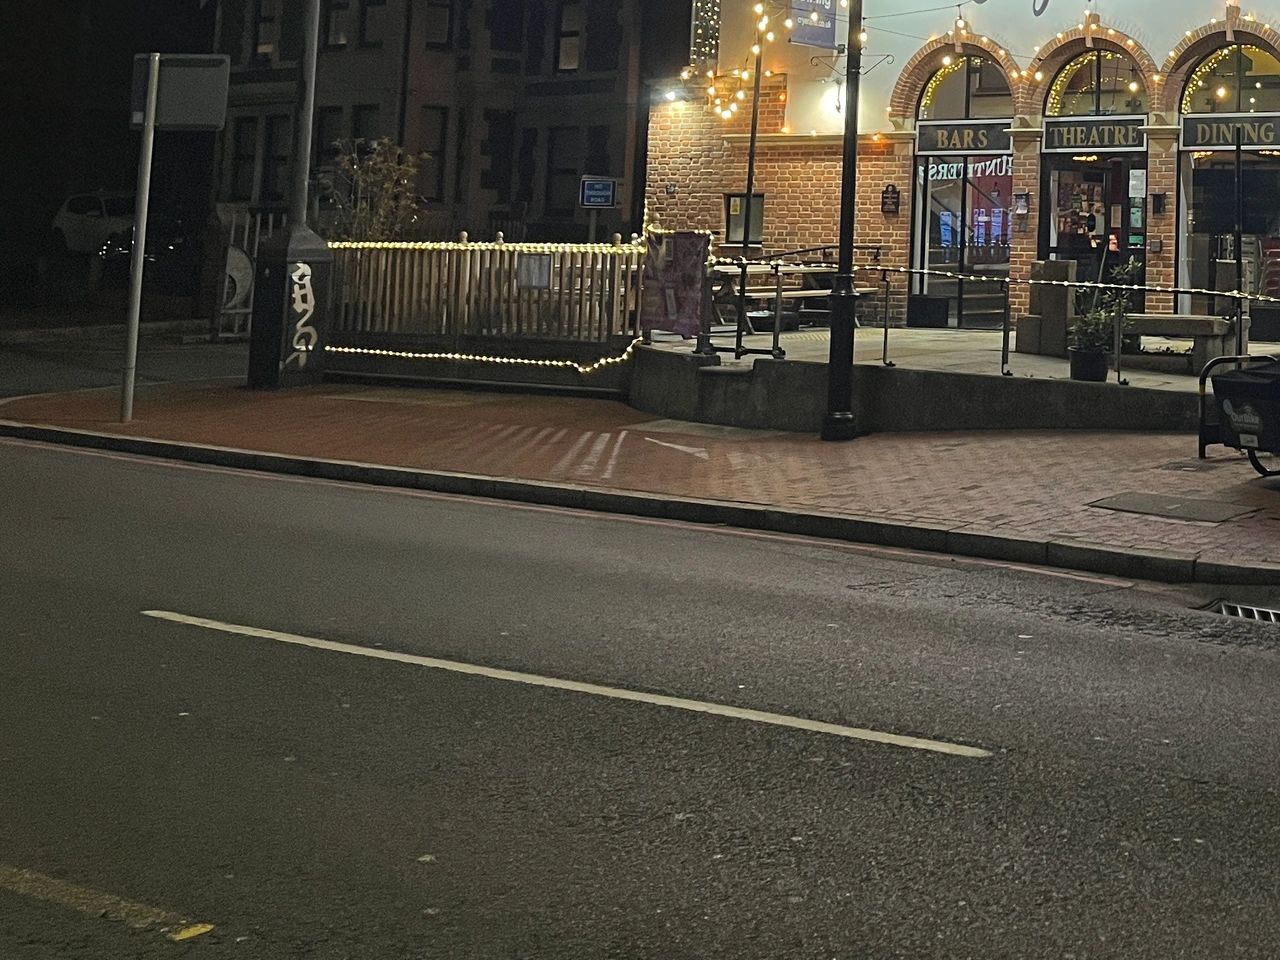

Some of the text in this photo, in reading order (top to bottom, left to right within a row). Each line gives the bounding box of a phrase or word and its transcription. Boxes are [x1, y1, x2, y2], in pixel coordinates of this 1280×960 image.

[936, 129, 988, 149] BARS
[1050, 125, 1139, 147] THEATRE
[1196, 122, 1275, 145] DINNG
